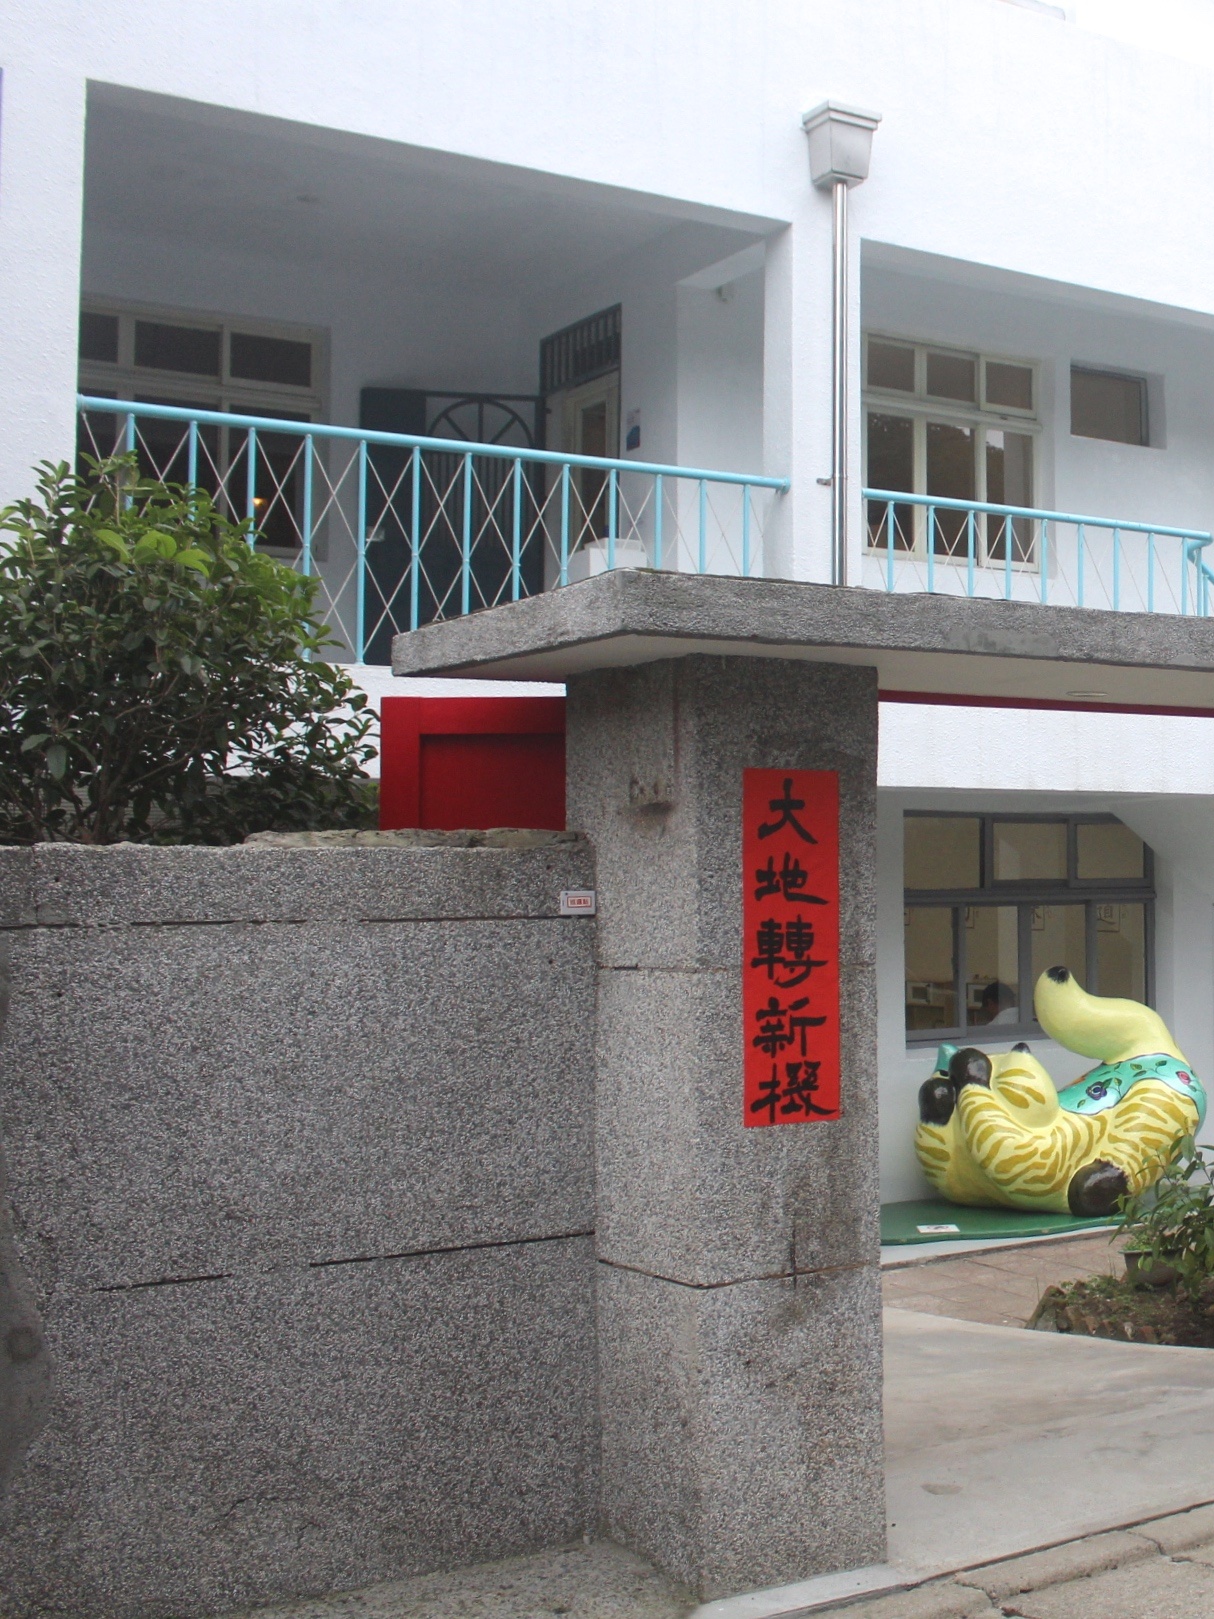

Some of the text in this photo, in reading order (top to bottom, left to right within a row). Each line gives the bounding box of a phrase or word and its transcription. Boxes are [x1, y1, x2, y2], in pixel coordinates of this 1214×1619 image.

[750, 778, 837, 1124] 大地轉新機
